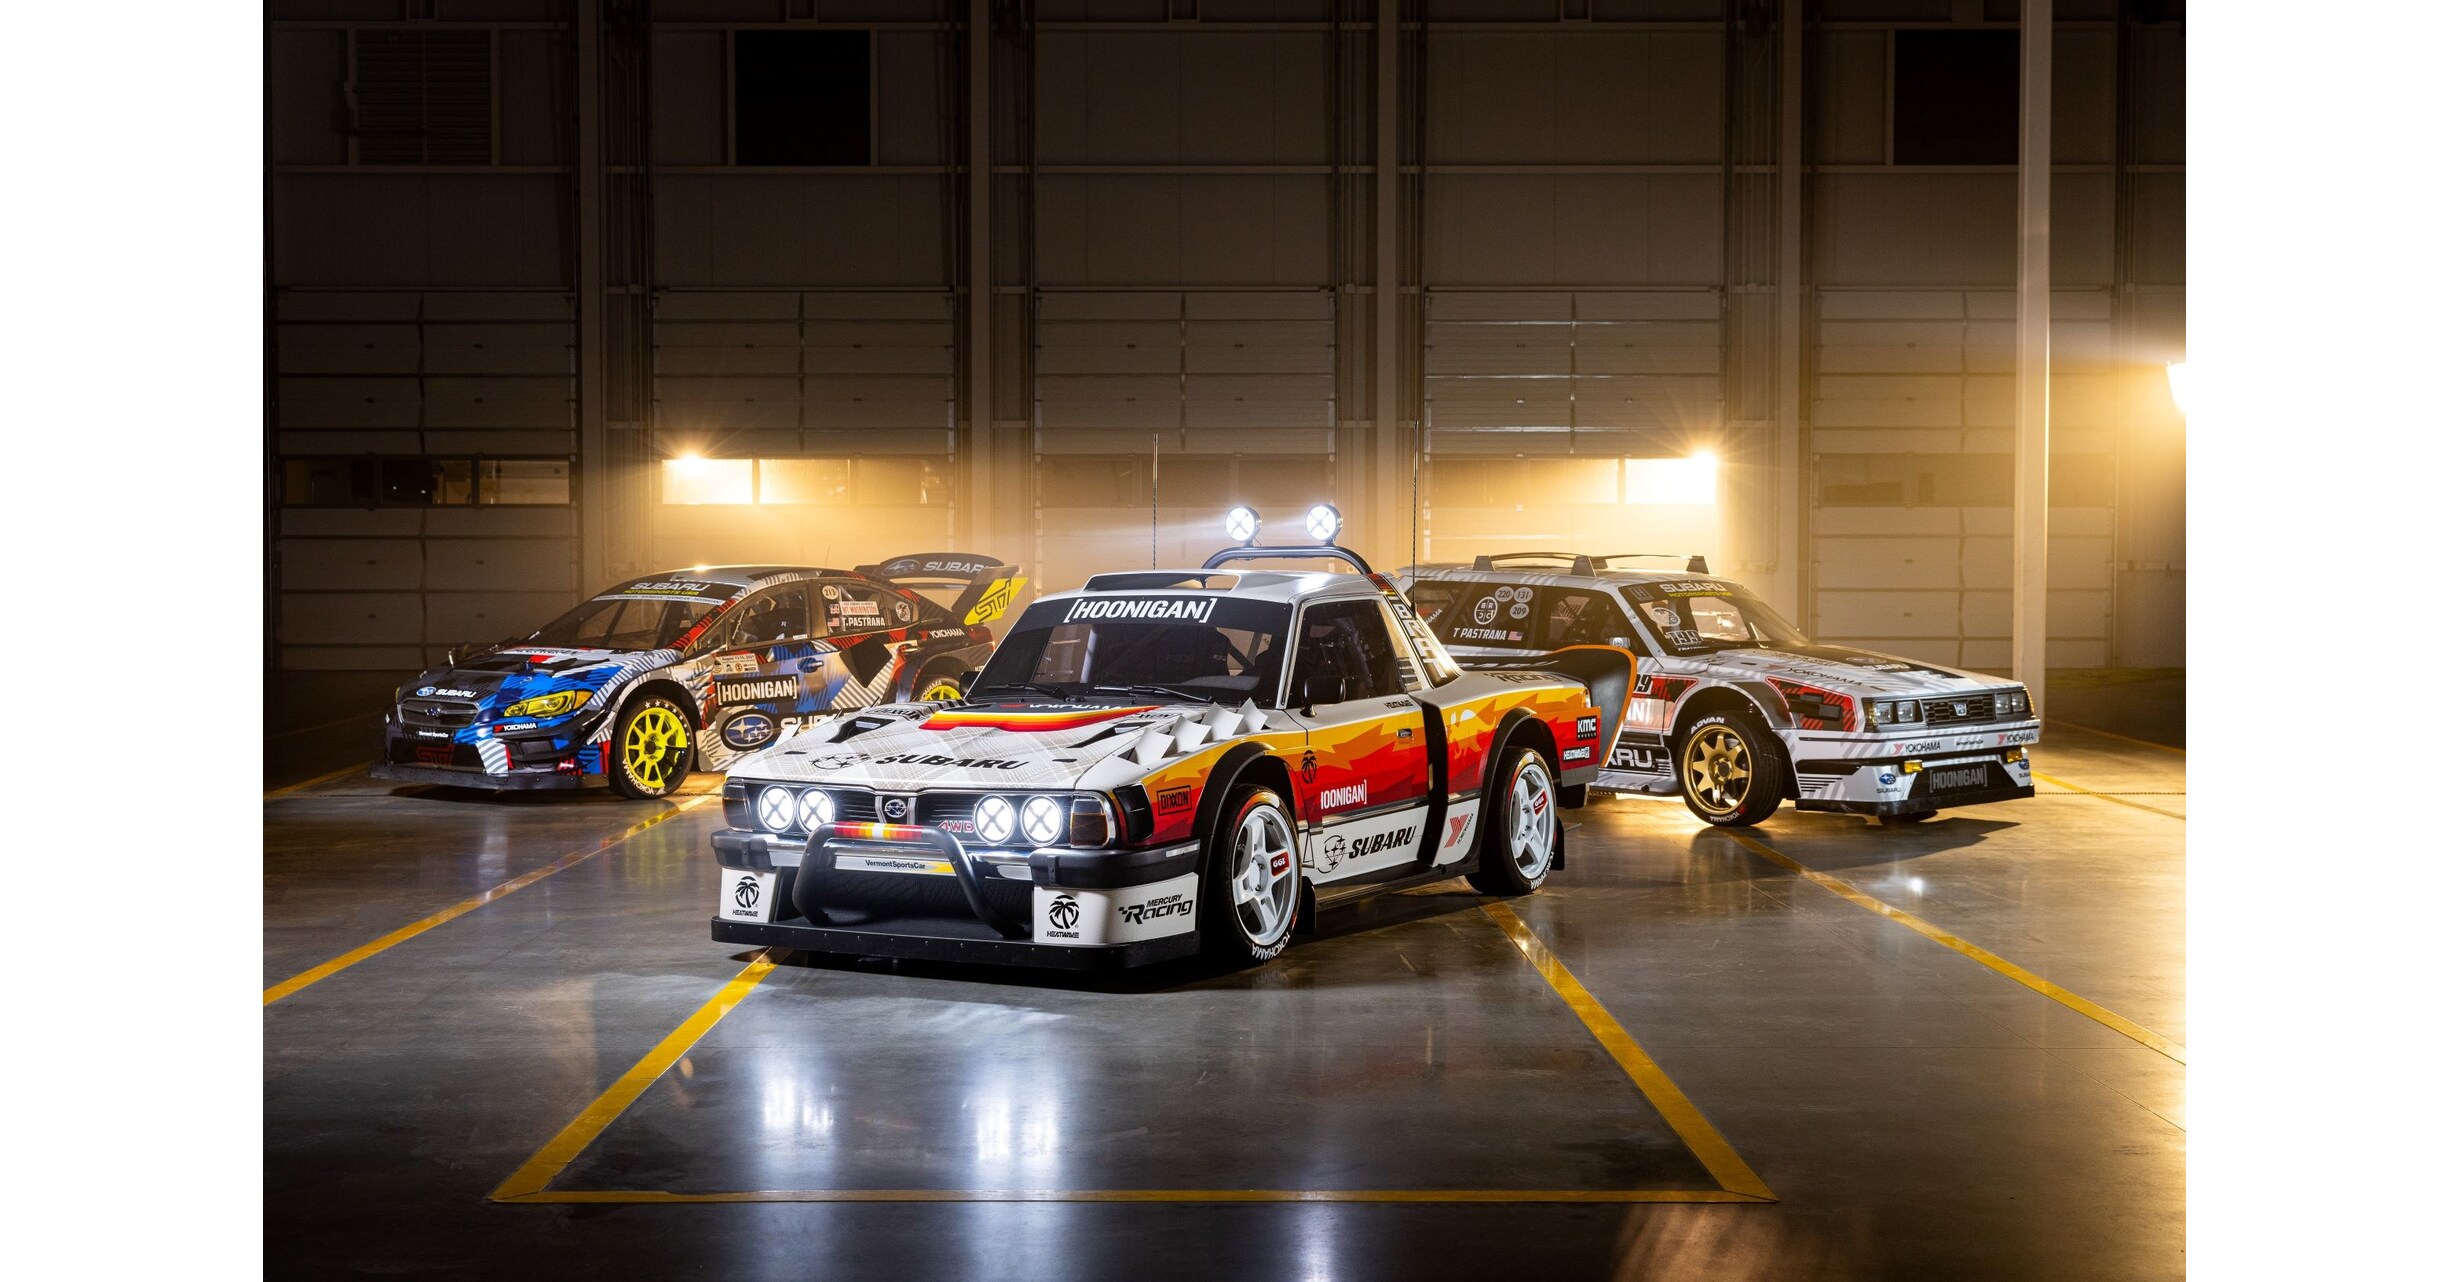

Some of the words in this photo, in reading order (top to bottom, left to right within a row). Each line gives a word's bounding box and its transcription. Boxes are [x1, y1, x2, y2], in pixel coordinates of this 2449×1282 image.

[630, 582, 711, 591] SUBARU
[1497, 589, 1511, 598] 220
[1660, 582, 1727, 593] SUBARU
[1517, 590, 1530, 599] 131
[1063, 598, 1218, 623] [HOONIGAN]
[1513, 606, 1527, 615] 209
[928, 628, 965, 639] YOKOHAMA
[1391, 603, 1448, 679] BRAT
[1453, 627, 1458, 638] T
[1460, 628, 1506, 641] PASTRANA
[1787, 667, 1864, 686] YOKOHAMA
[435, 688, 477, 698] SUBARU
[717, 676, 797, 706] [HOONIGAN]
[503, 722, 537, 732] YOKOHAMA
[1577, 717, 1597, 733] KMC
[1690, 716, 1725, 735] ADVAN
[2006, 732, 2035, 744] YOKOHAMA
[1904, 741, 1941, 753] YOKOHAMA
[876, 755, 1032, 770] SUBARU
[622, 758, 655, 795] YOKOHAMA
[1160, 791, 1190, 810] DIXXON
[938, 820, 975, 834] 4WD
[1348, 825, 1417, 860] SUBARU
[1146, 893, 1183, 908] MERCURY
[1124, 899, 1194, 925] Racing
[1251, 932, 1291, 961] YOKOHAMA
